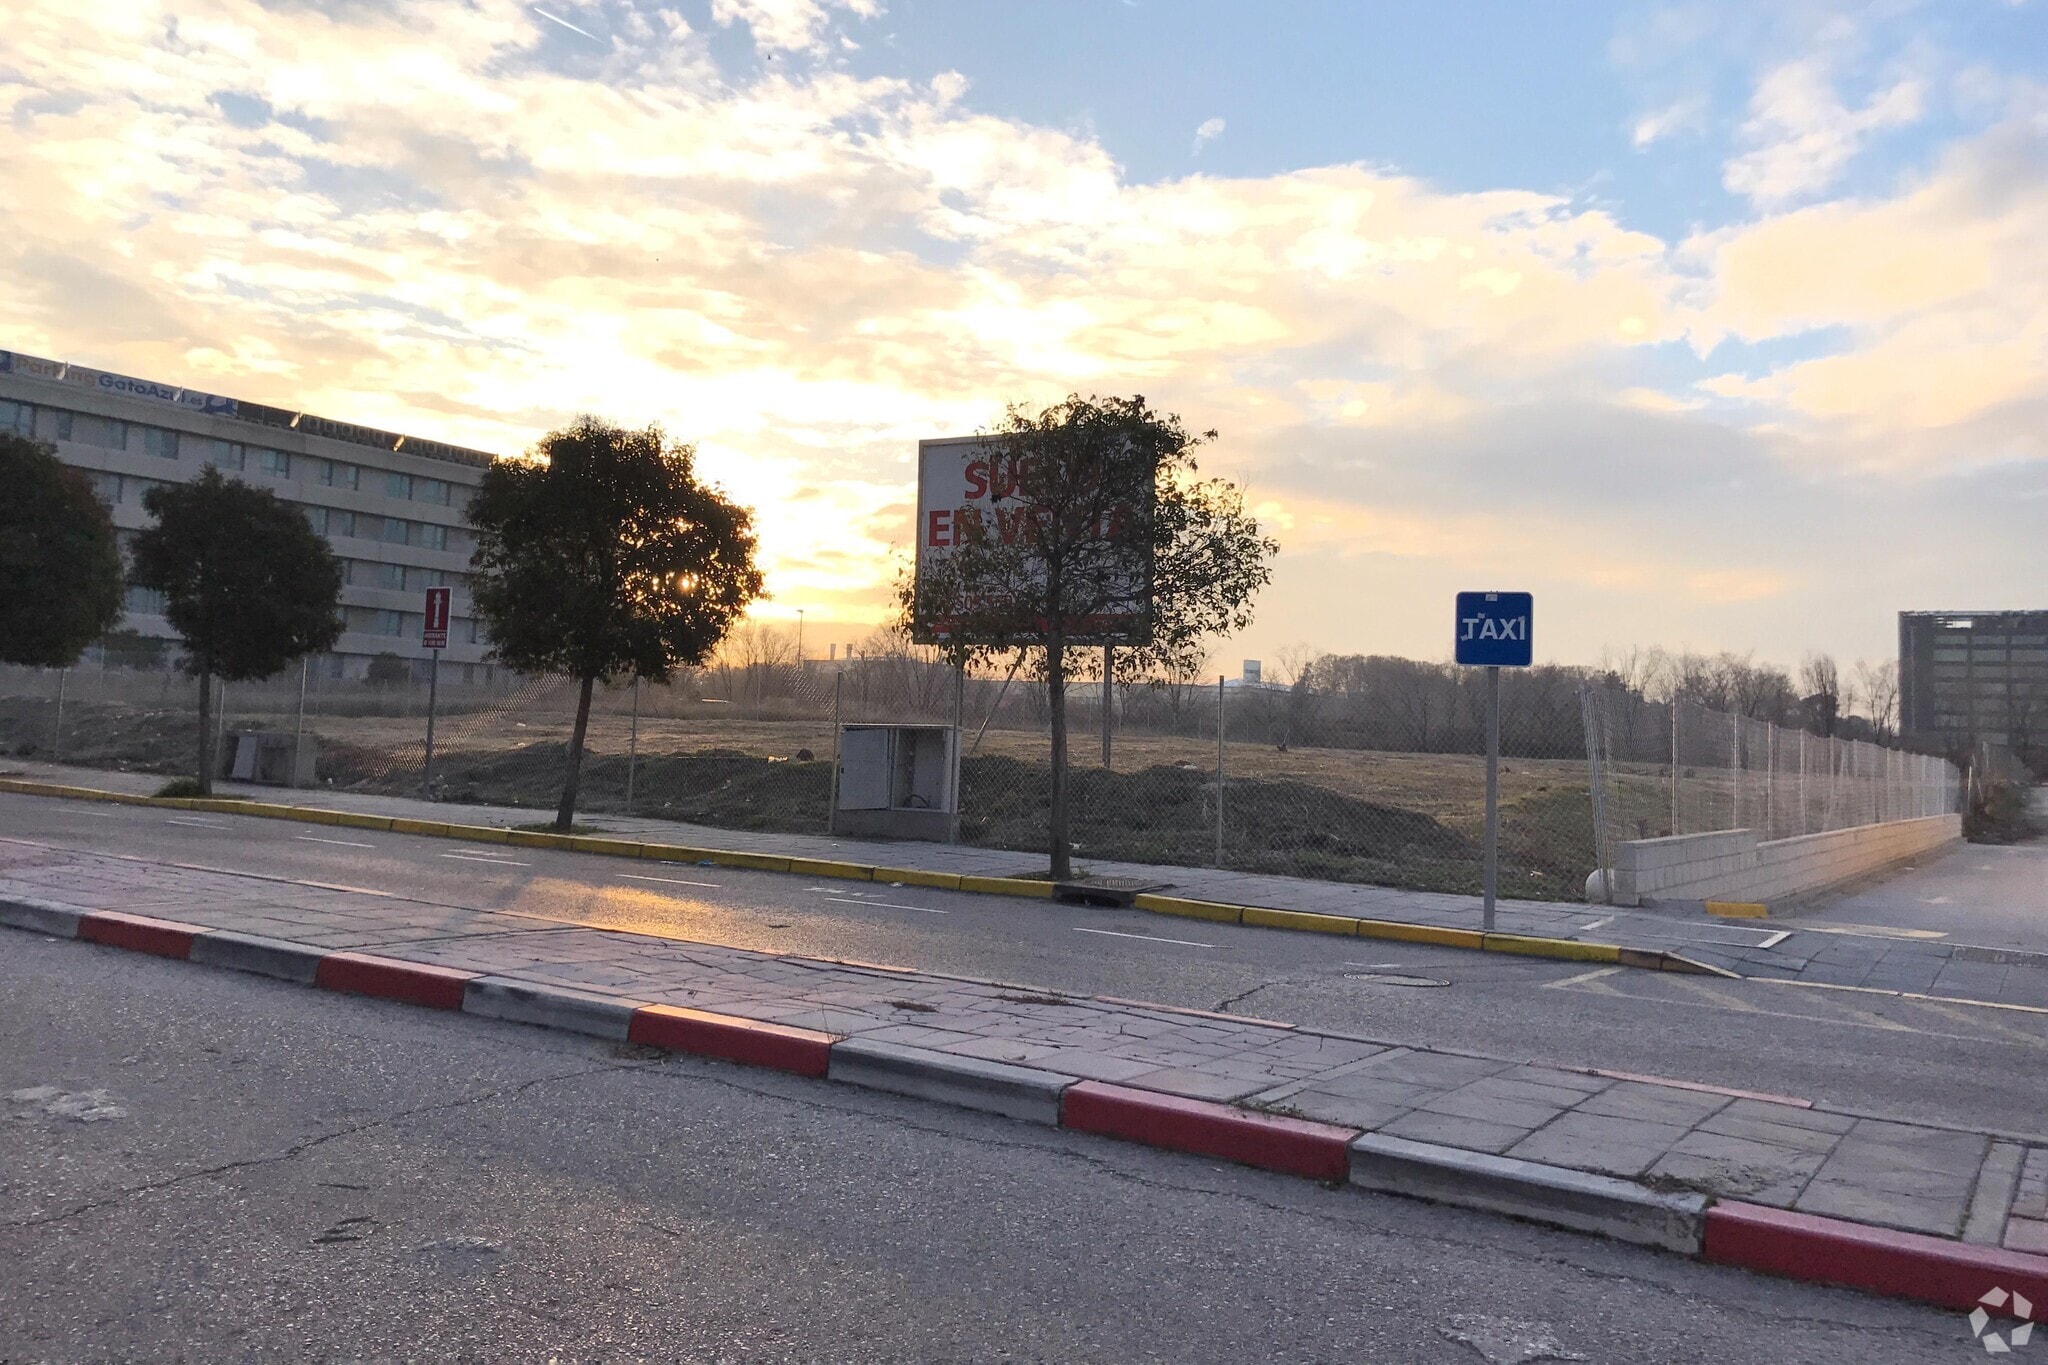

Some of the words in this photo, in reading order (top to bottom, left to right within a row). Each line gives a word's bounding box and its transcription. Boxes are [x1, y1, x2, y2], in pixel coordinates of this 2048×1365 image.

[964, 455, 1102, 499] SUEO
[928, 510, 984, 546] EN
[995, 502, 1139, 545] VEA
[1461, 616, 1526, 641] TAXI
